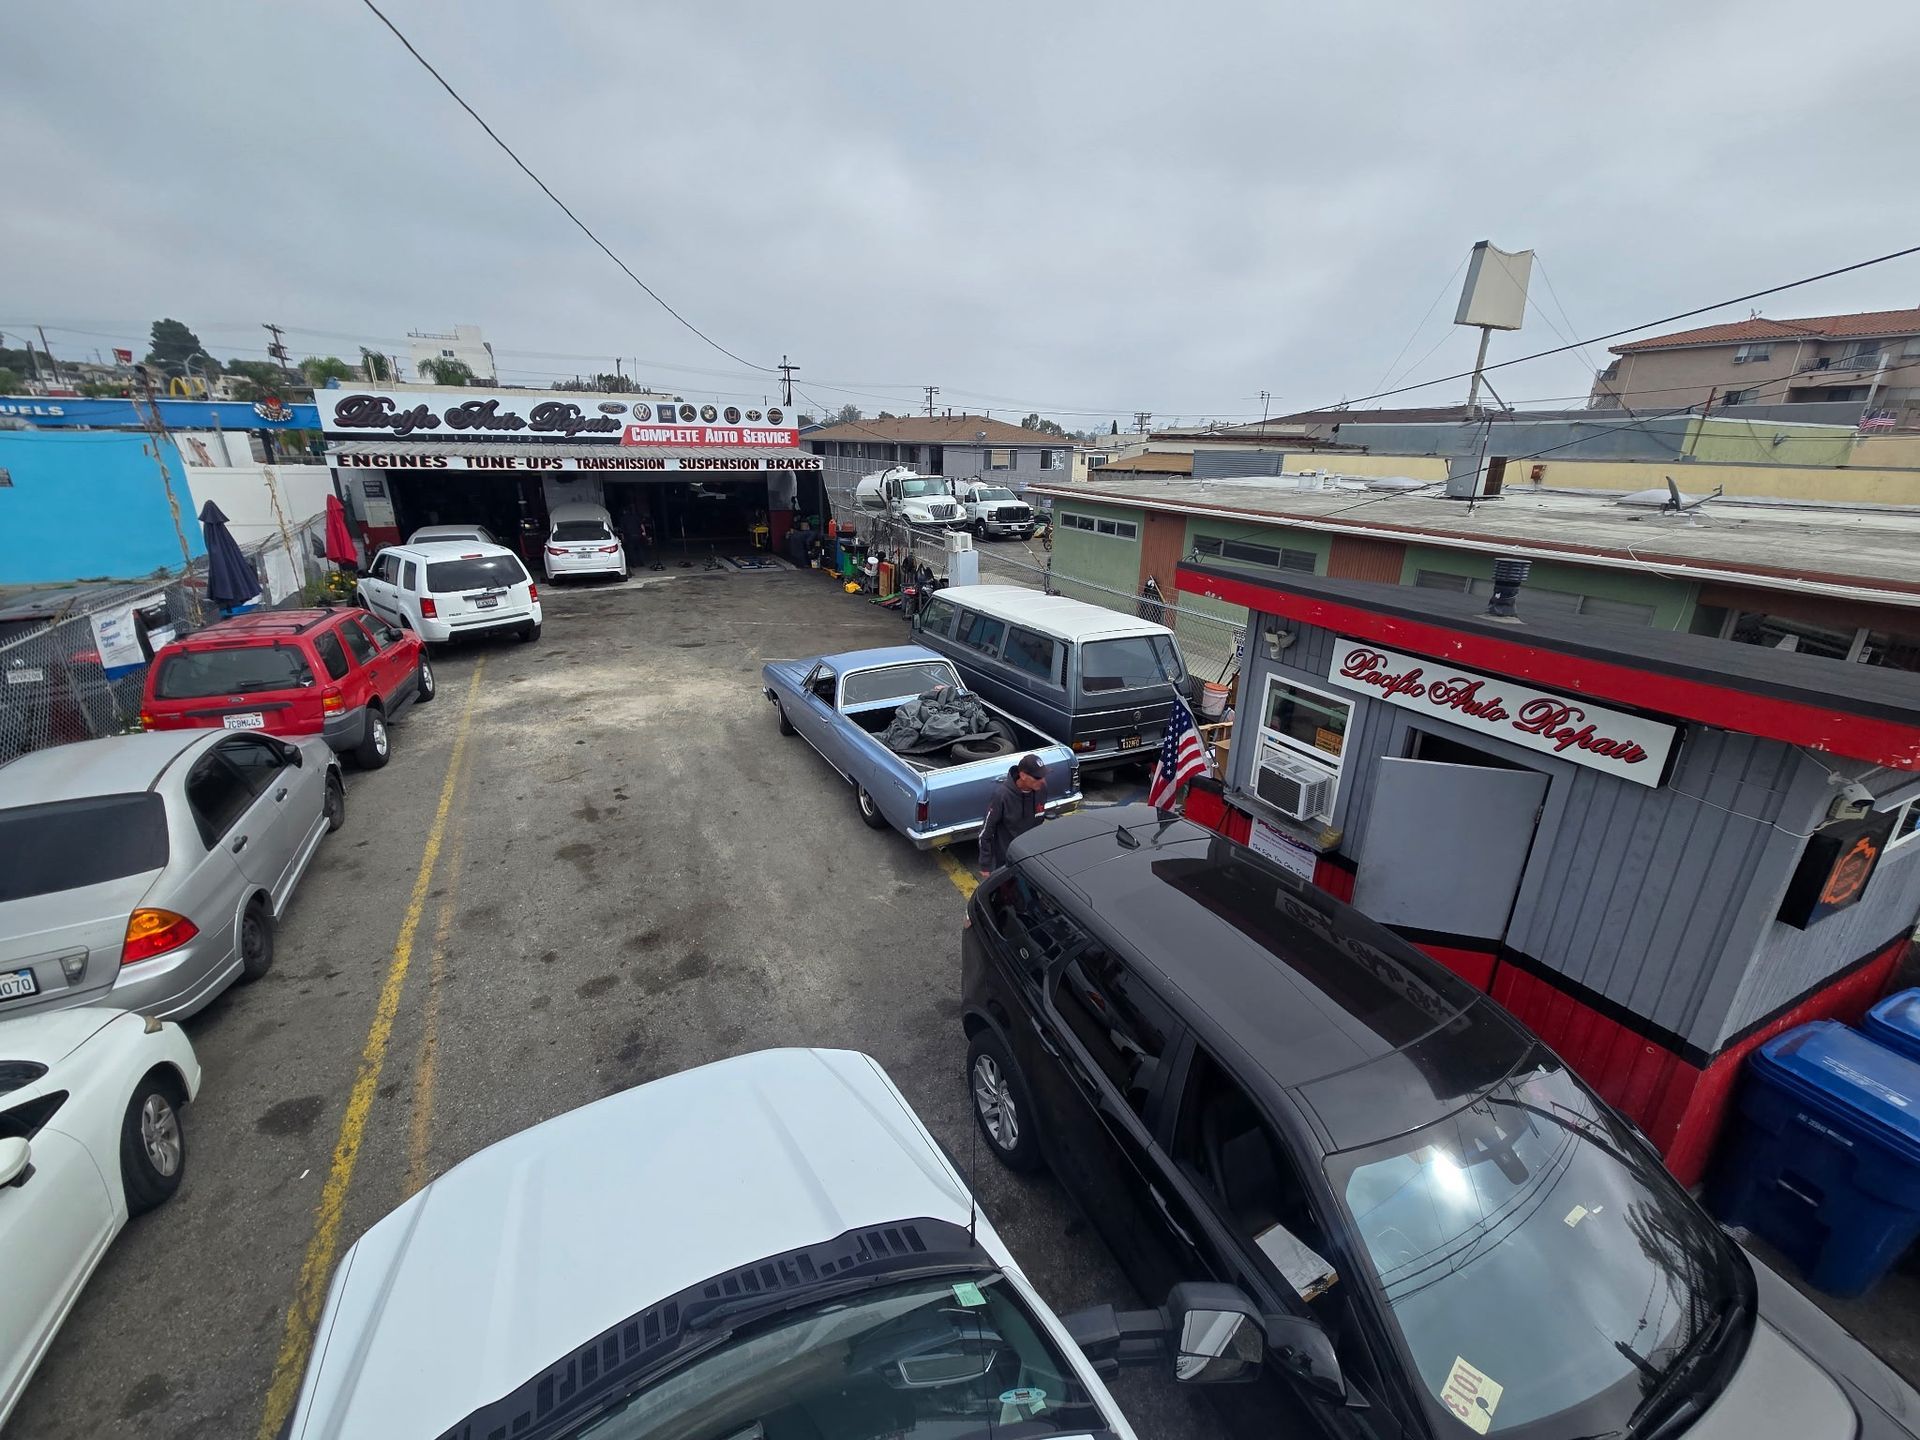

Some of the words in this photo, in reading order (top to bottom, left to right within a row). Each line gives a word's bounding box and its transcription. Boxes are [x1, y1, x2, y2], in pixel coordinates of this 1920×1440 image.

[333, 394, 441, 436] Pacific
[444, 399, 527, 431] Auto
[528, 401, 622, 438] Repair
[631, 427, 699, 443] COMPLETE
[705, 428, 738, 443] AUTO
[743, 429, 791, 444] SERVICE
[337, 455, 448, 468] ENGINES
[464, 456, 563, 469] TUNE-UPS
[575, 458, 665, 470] TRANSMISSION
[679, 458, 759, 470] SUSPENSION
[766, 459, 820, 470] BRAKES
[1340, 648, 1426, 700] Pacific
[1428, 676, 1510, 722] Auto
[1512, 697, 1648, 765] Repair
[0, 978, 31, 996] 070
